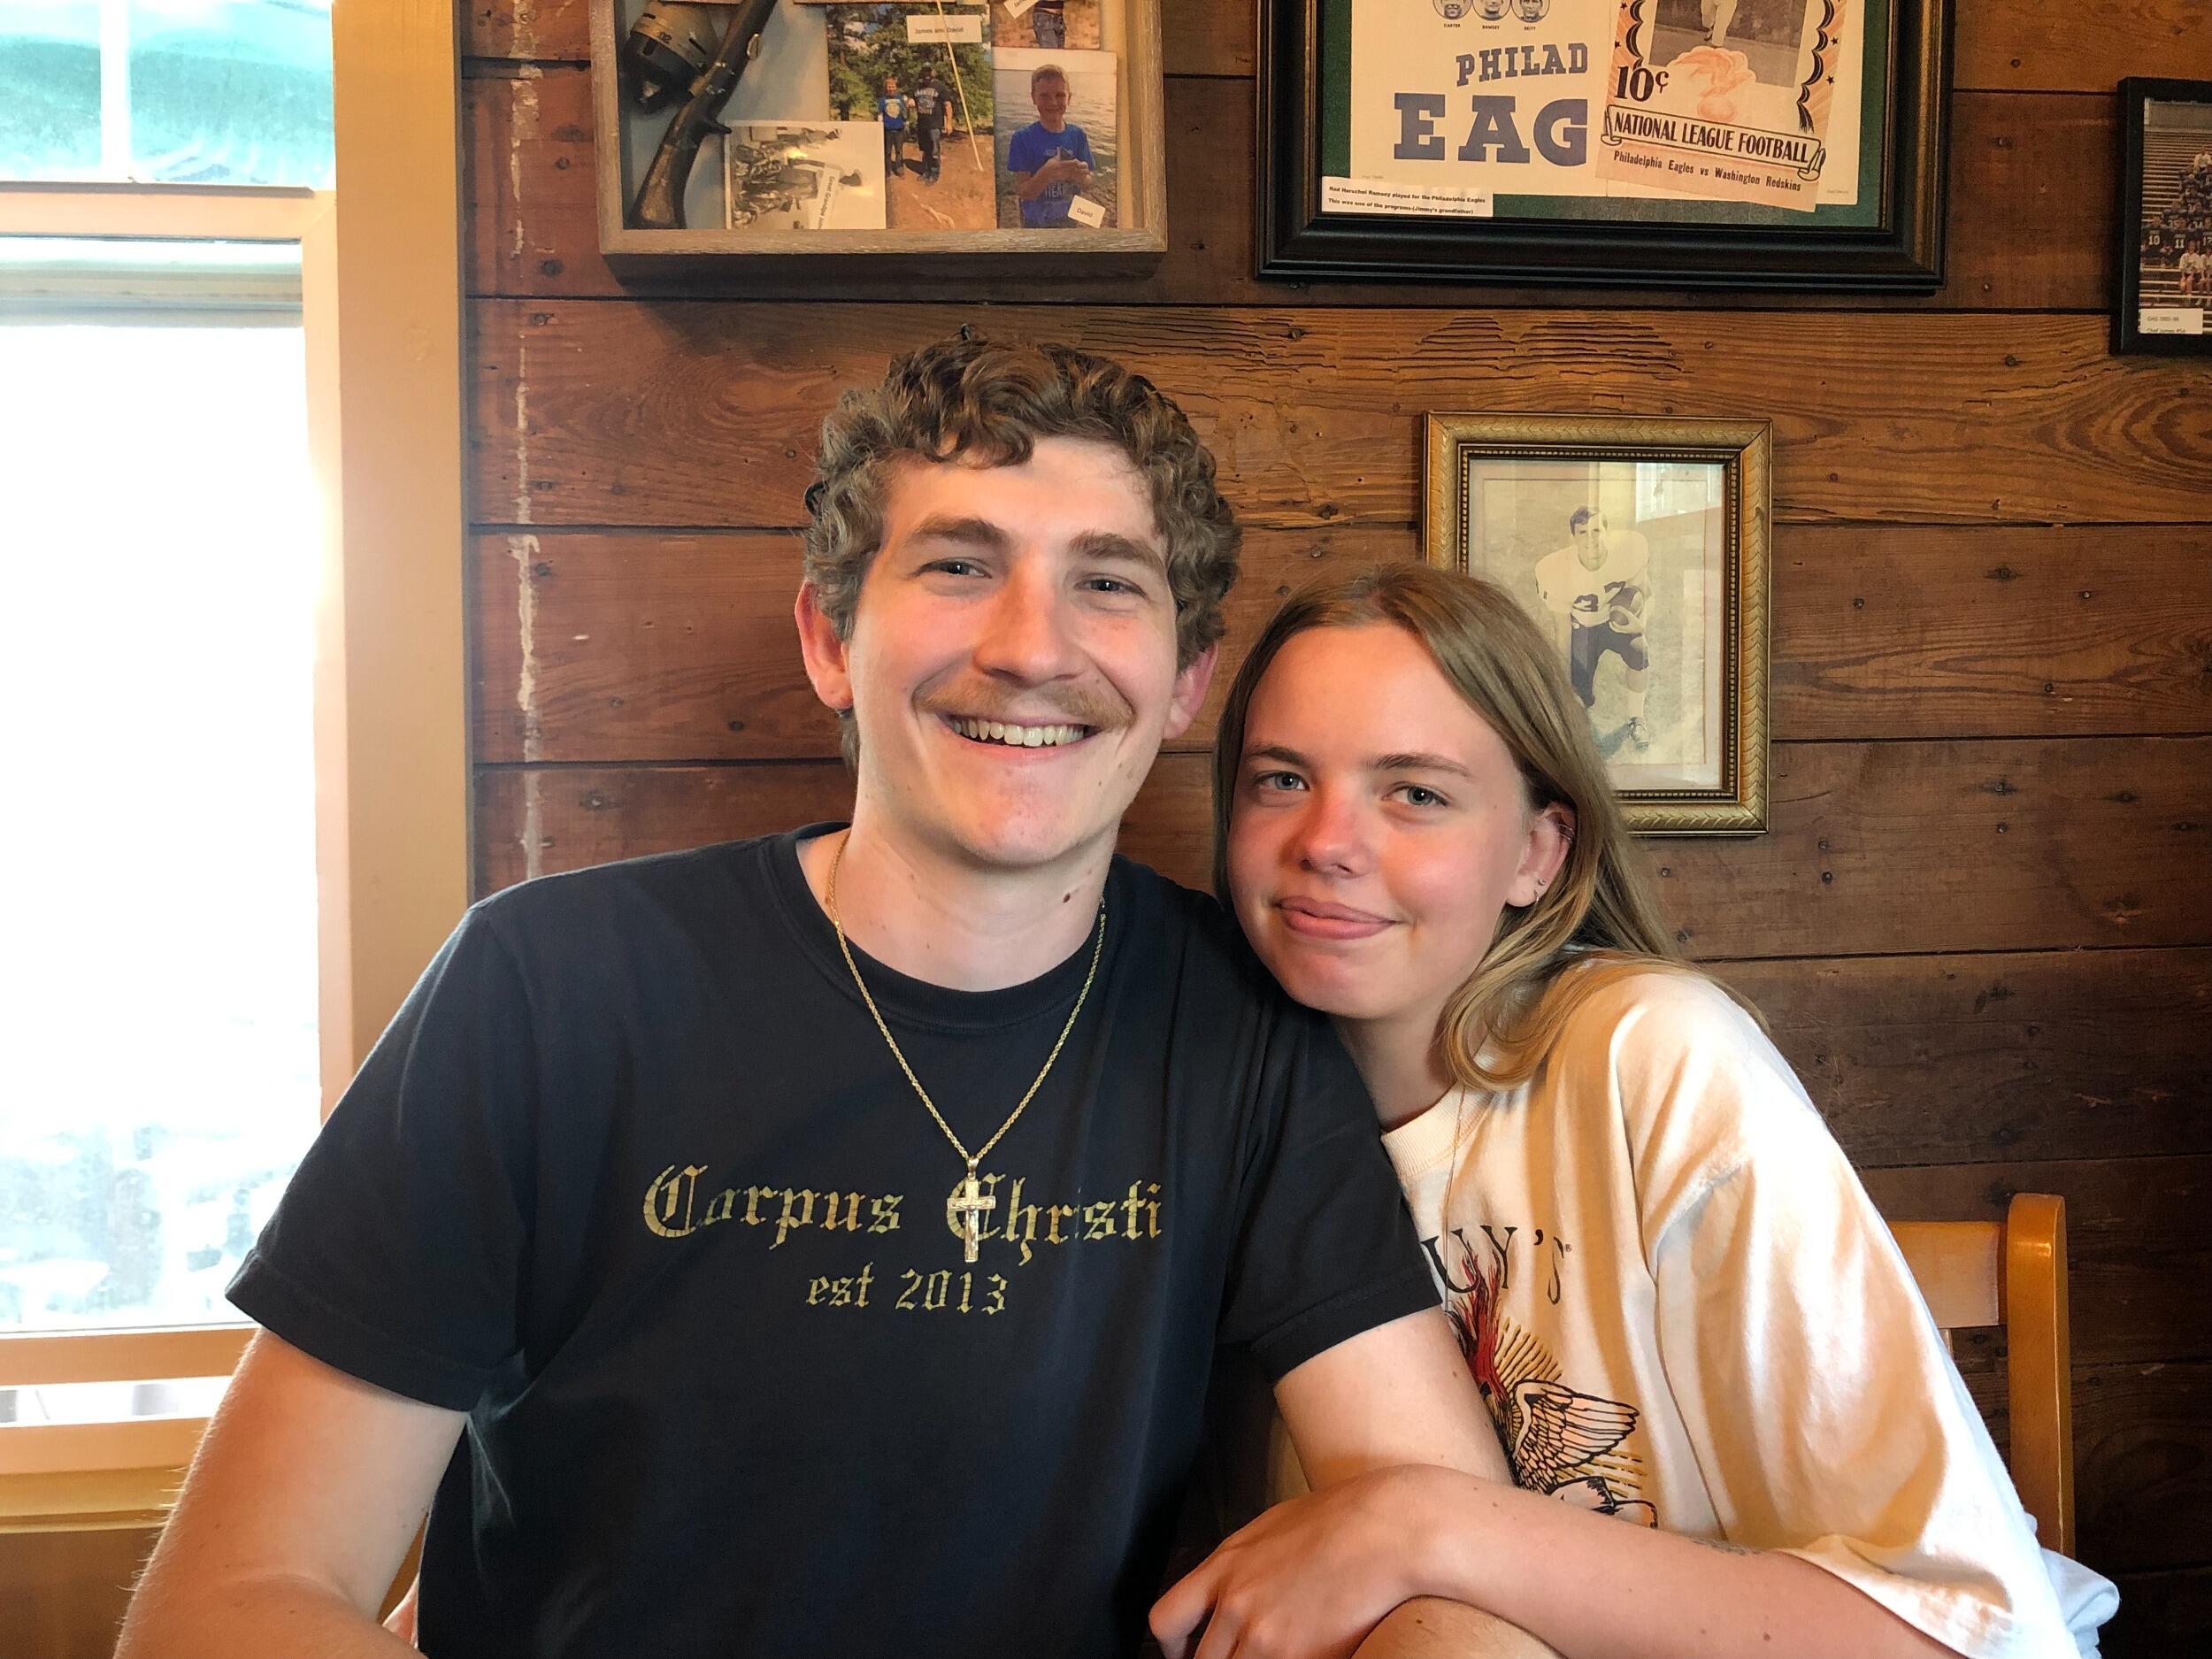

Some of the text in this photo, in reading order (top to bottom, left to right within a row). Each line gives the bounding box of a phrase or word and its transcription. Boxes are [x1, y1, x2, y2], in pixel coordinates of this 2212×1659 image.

[1455, 42, 1588, 87] PHILAD
[1394, 92, 1588, 166] EAG
[1614, 111, 1809, 164] NATIONAL LEAGUE FOOTBALL
[1613, 150, 1801, 192] Philadelphia Eagles vs Washington Redskins
[642, 1164, 1162, 1266] Corpus Chrsti
[806, 1261, 1009, 1315] est 2013
